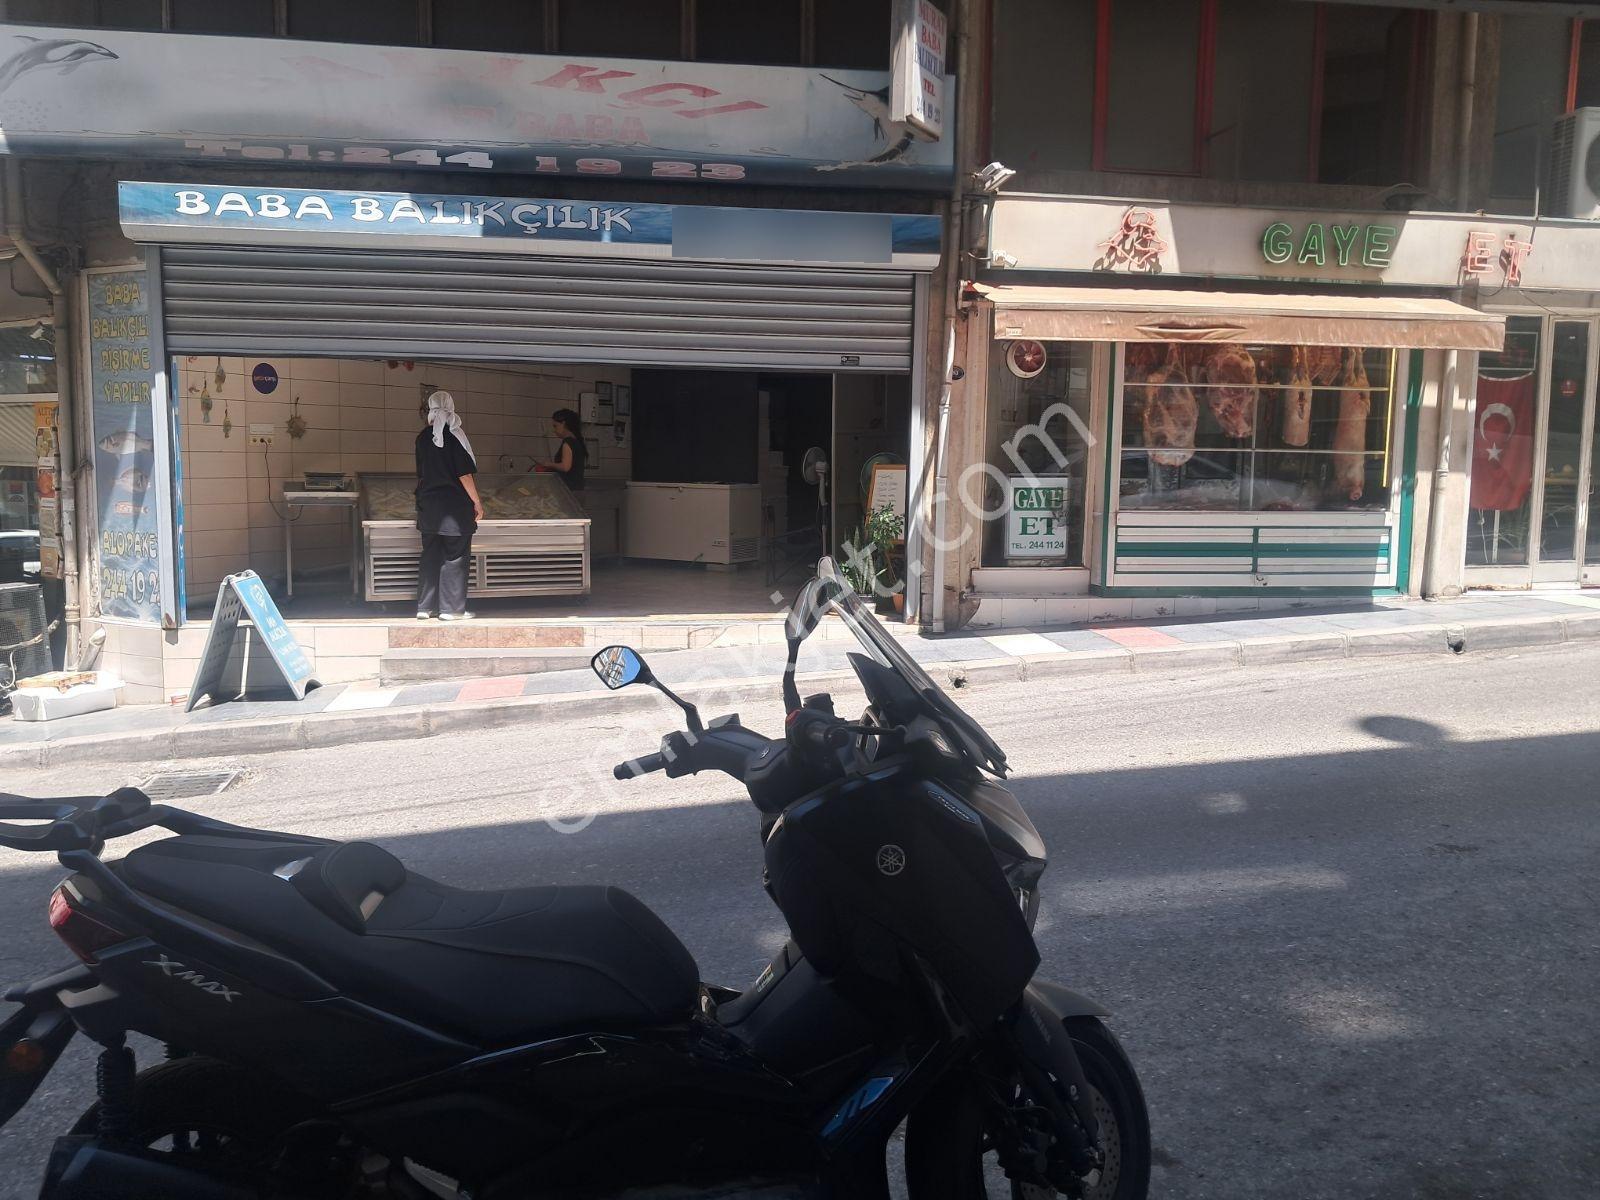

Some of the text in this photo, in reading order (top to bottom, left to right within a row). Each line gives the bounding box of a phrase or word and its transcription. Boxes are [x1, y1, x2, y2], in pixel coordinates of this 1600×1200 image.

[921, 24, 941, 54] BABA
[174, 190, 633, 235] BABA BALIKÇILIK
[1263, 222, 1533, 280] GAYE ET
[105, 282, 140, 306] BABA
[101, 345, 151, 376] PİŞİRME
[103, 380, 151, 403] YAPILIR
[1014, 489, 1062, 509] GAYE
[1018, 516, 1060, 536] ET
[1029, 540, 1044, 550] 244
[103, 566, 160, 607] 244 19 2
